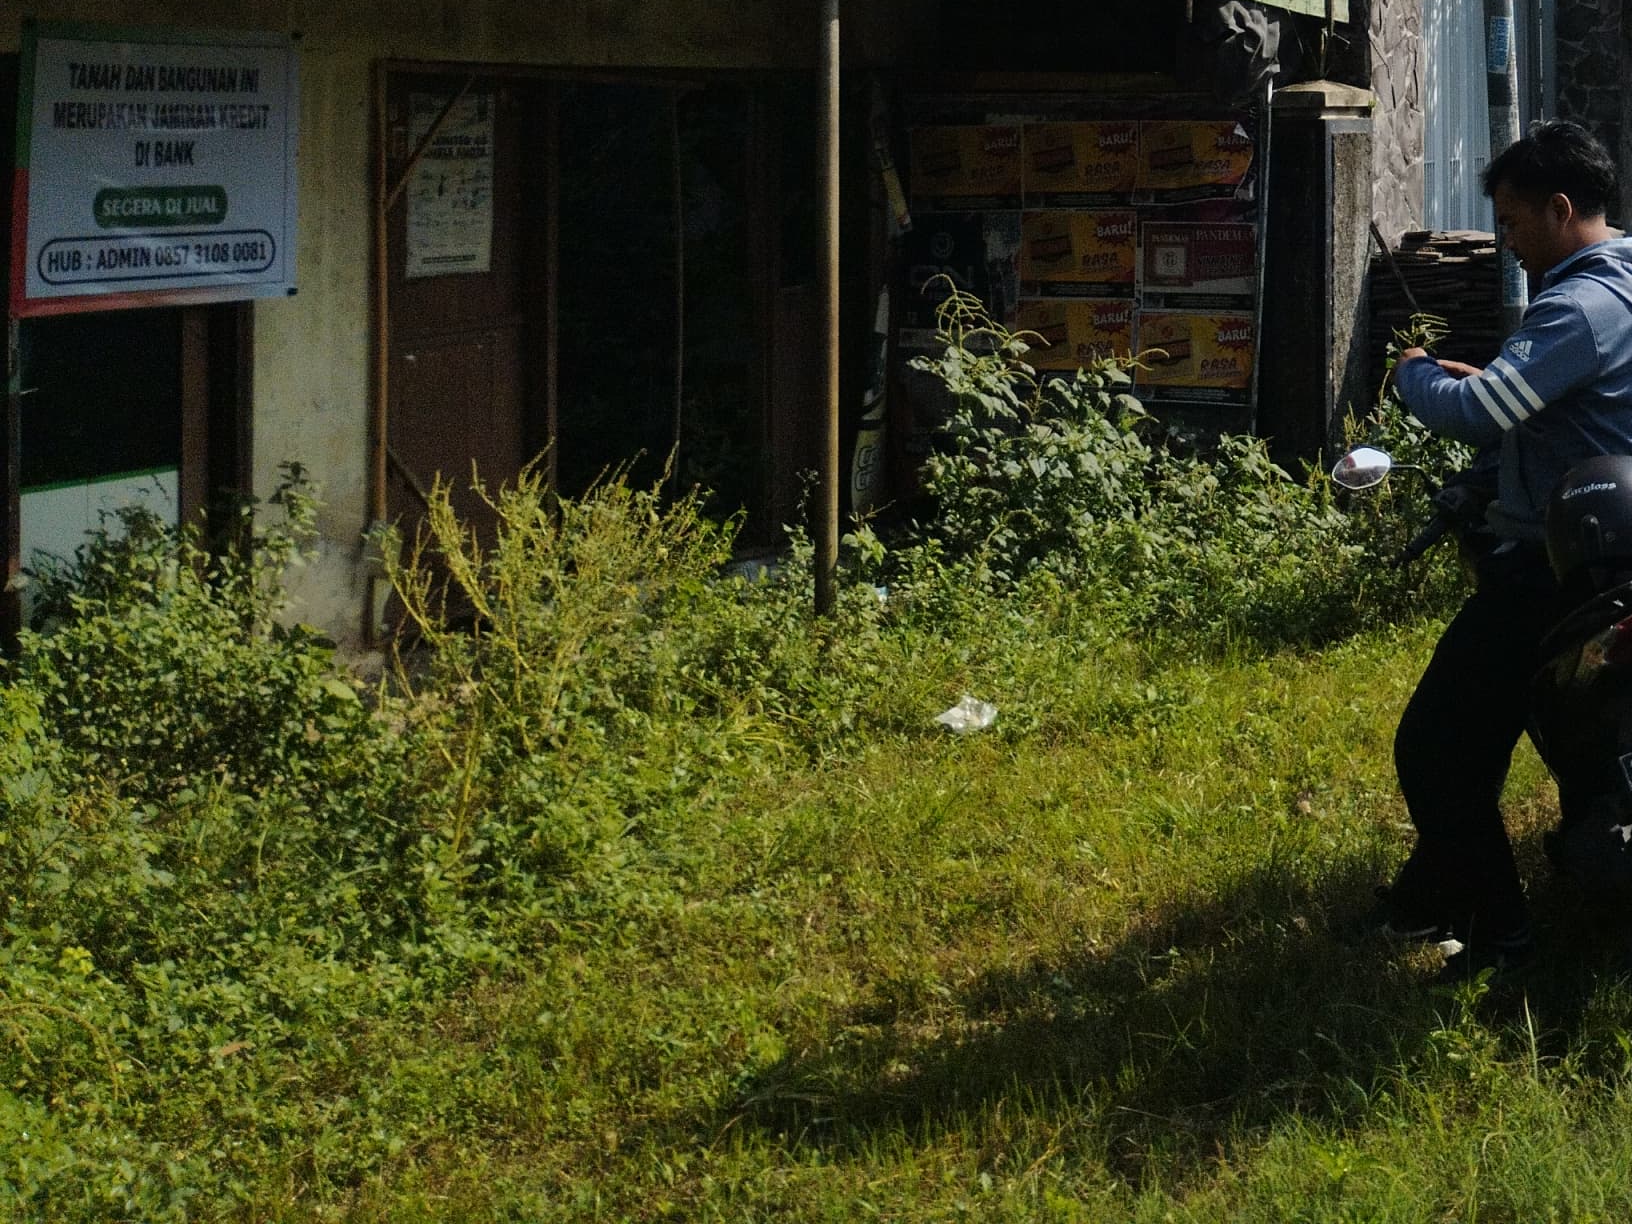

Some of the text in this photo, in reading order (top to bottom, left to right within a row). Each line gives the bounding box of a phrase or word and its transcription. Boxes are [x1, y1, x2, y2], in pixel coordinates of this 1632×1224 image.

[69, 63, 259, 93] TANAH DAN BANGUNAN INI
[53, 102, 270, 129] MERUPAKAN JAMINAN KREDIT
[1099, 130, 1135, 147] BARU!
[135, 141, 195, 166] DI BANK
[103, 197, 220, 217] SEGERA DI JUAL
[1096, 220, 1132, 237] BARU!
[48, 251, 82, 273] HUB
[97, 247, 151, 270] ADMIN
[155, 245, 189, 267] 0857
[233, 241, 266, 262] 0081
[1217, 326, 1253, 342] BARU!
